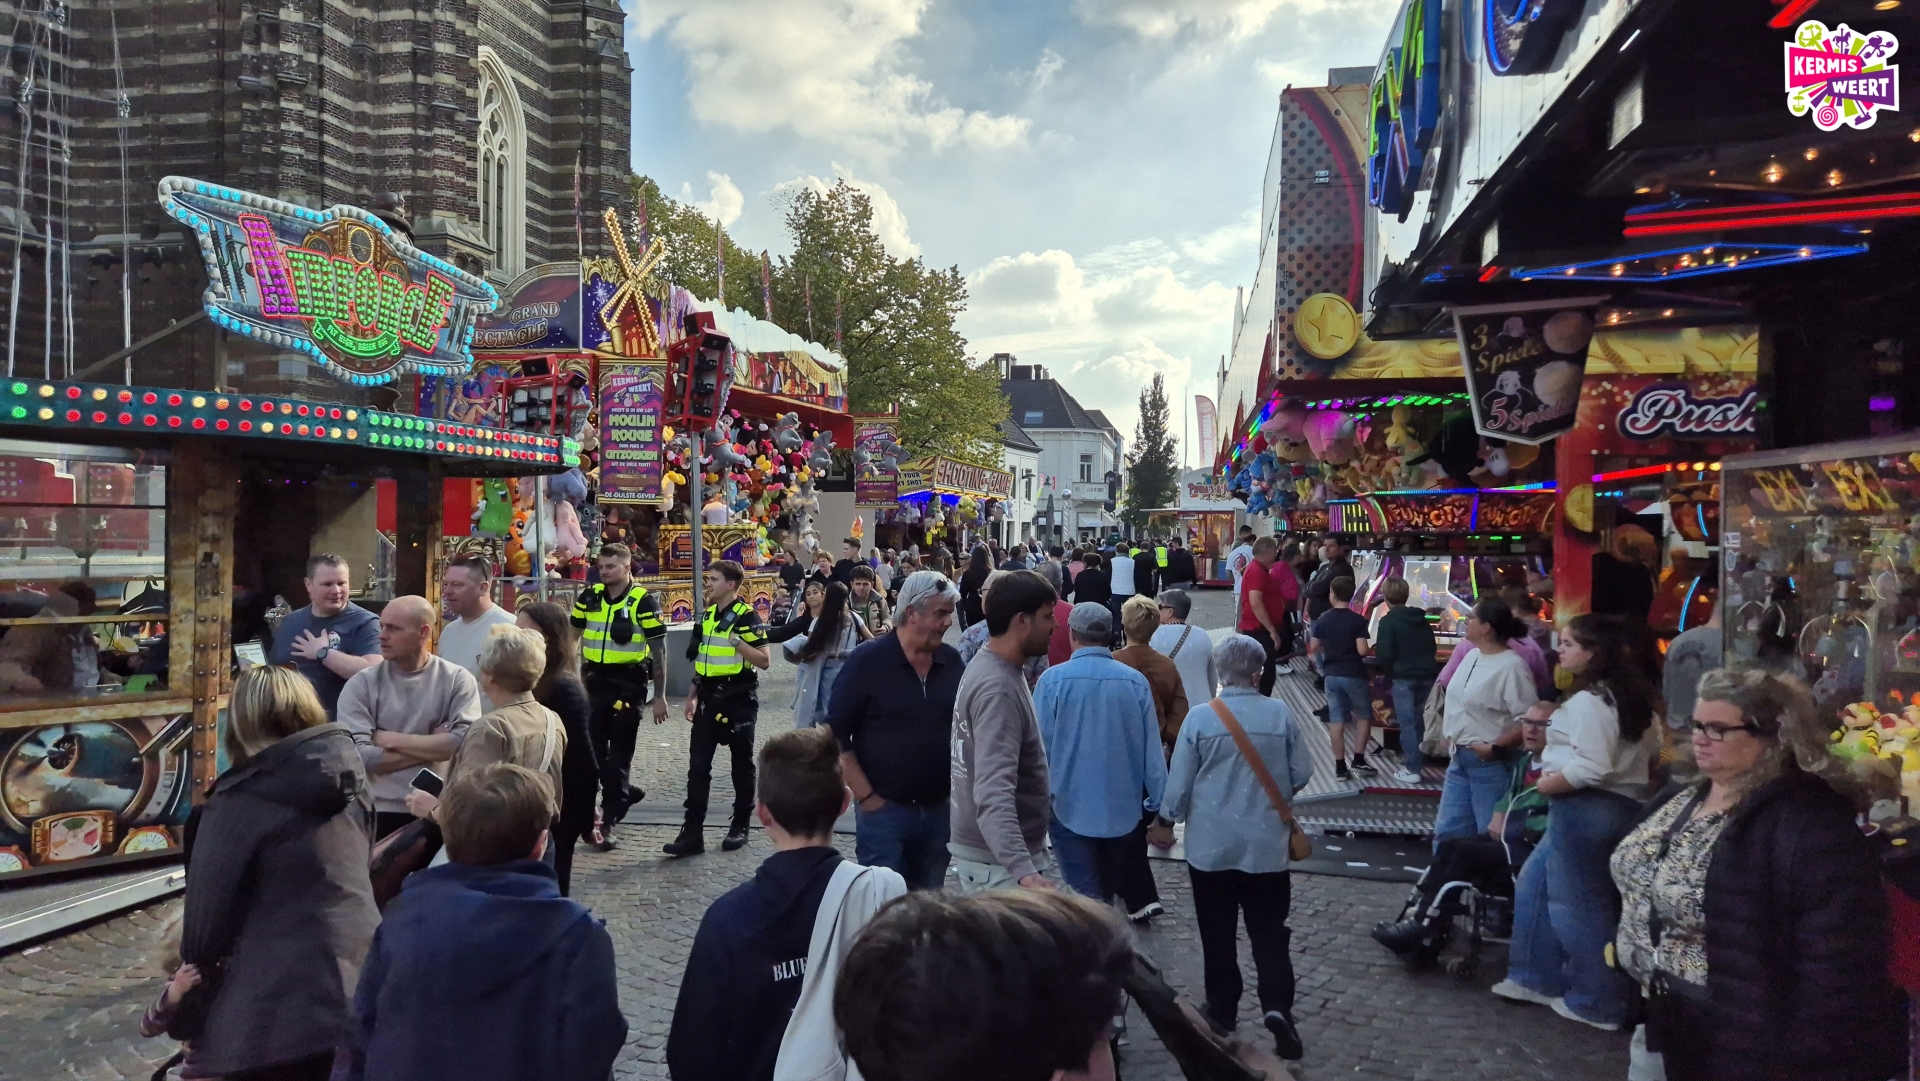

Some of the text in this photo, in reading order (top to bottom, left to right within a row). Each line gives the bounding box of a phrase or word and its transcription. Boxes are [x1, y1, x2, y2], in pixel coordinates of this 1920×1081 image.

[511, 303, 559, 323] GRAND
[474, 321, 546, 347] ECTACLE
[1470, 324, 1489, 351] 3
[612, 376, 638, 387] KERMIS
[628, 383, 651, 392] WEERT
[1486, 396, 1509, 430] 5
[608, 414, 656, 427] MOULIN
[611, 428, 653, 442] ROUGE
[605, 449, 658, 461] UITZOEKEN
[903, 471, 921, 479] YOUR
[604, 491, 613, 499] DE
[1387, 504, 1423, 527] FUN
